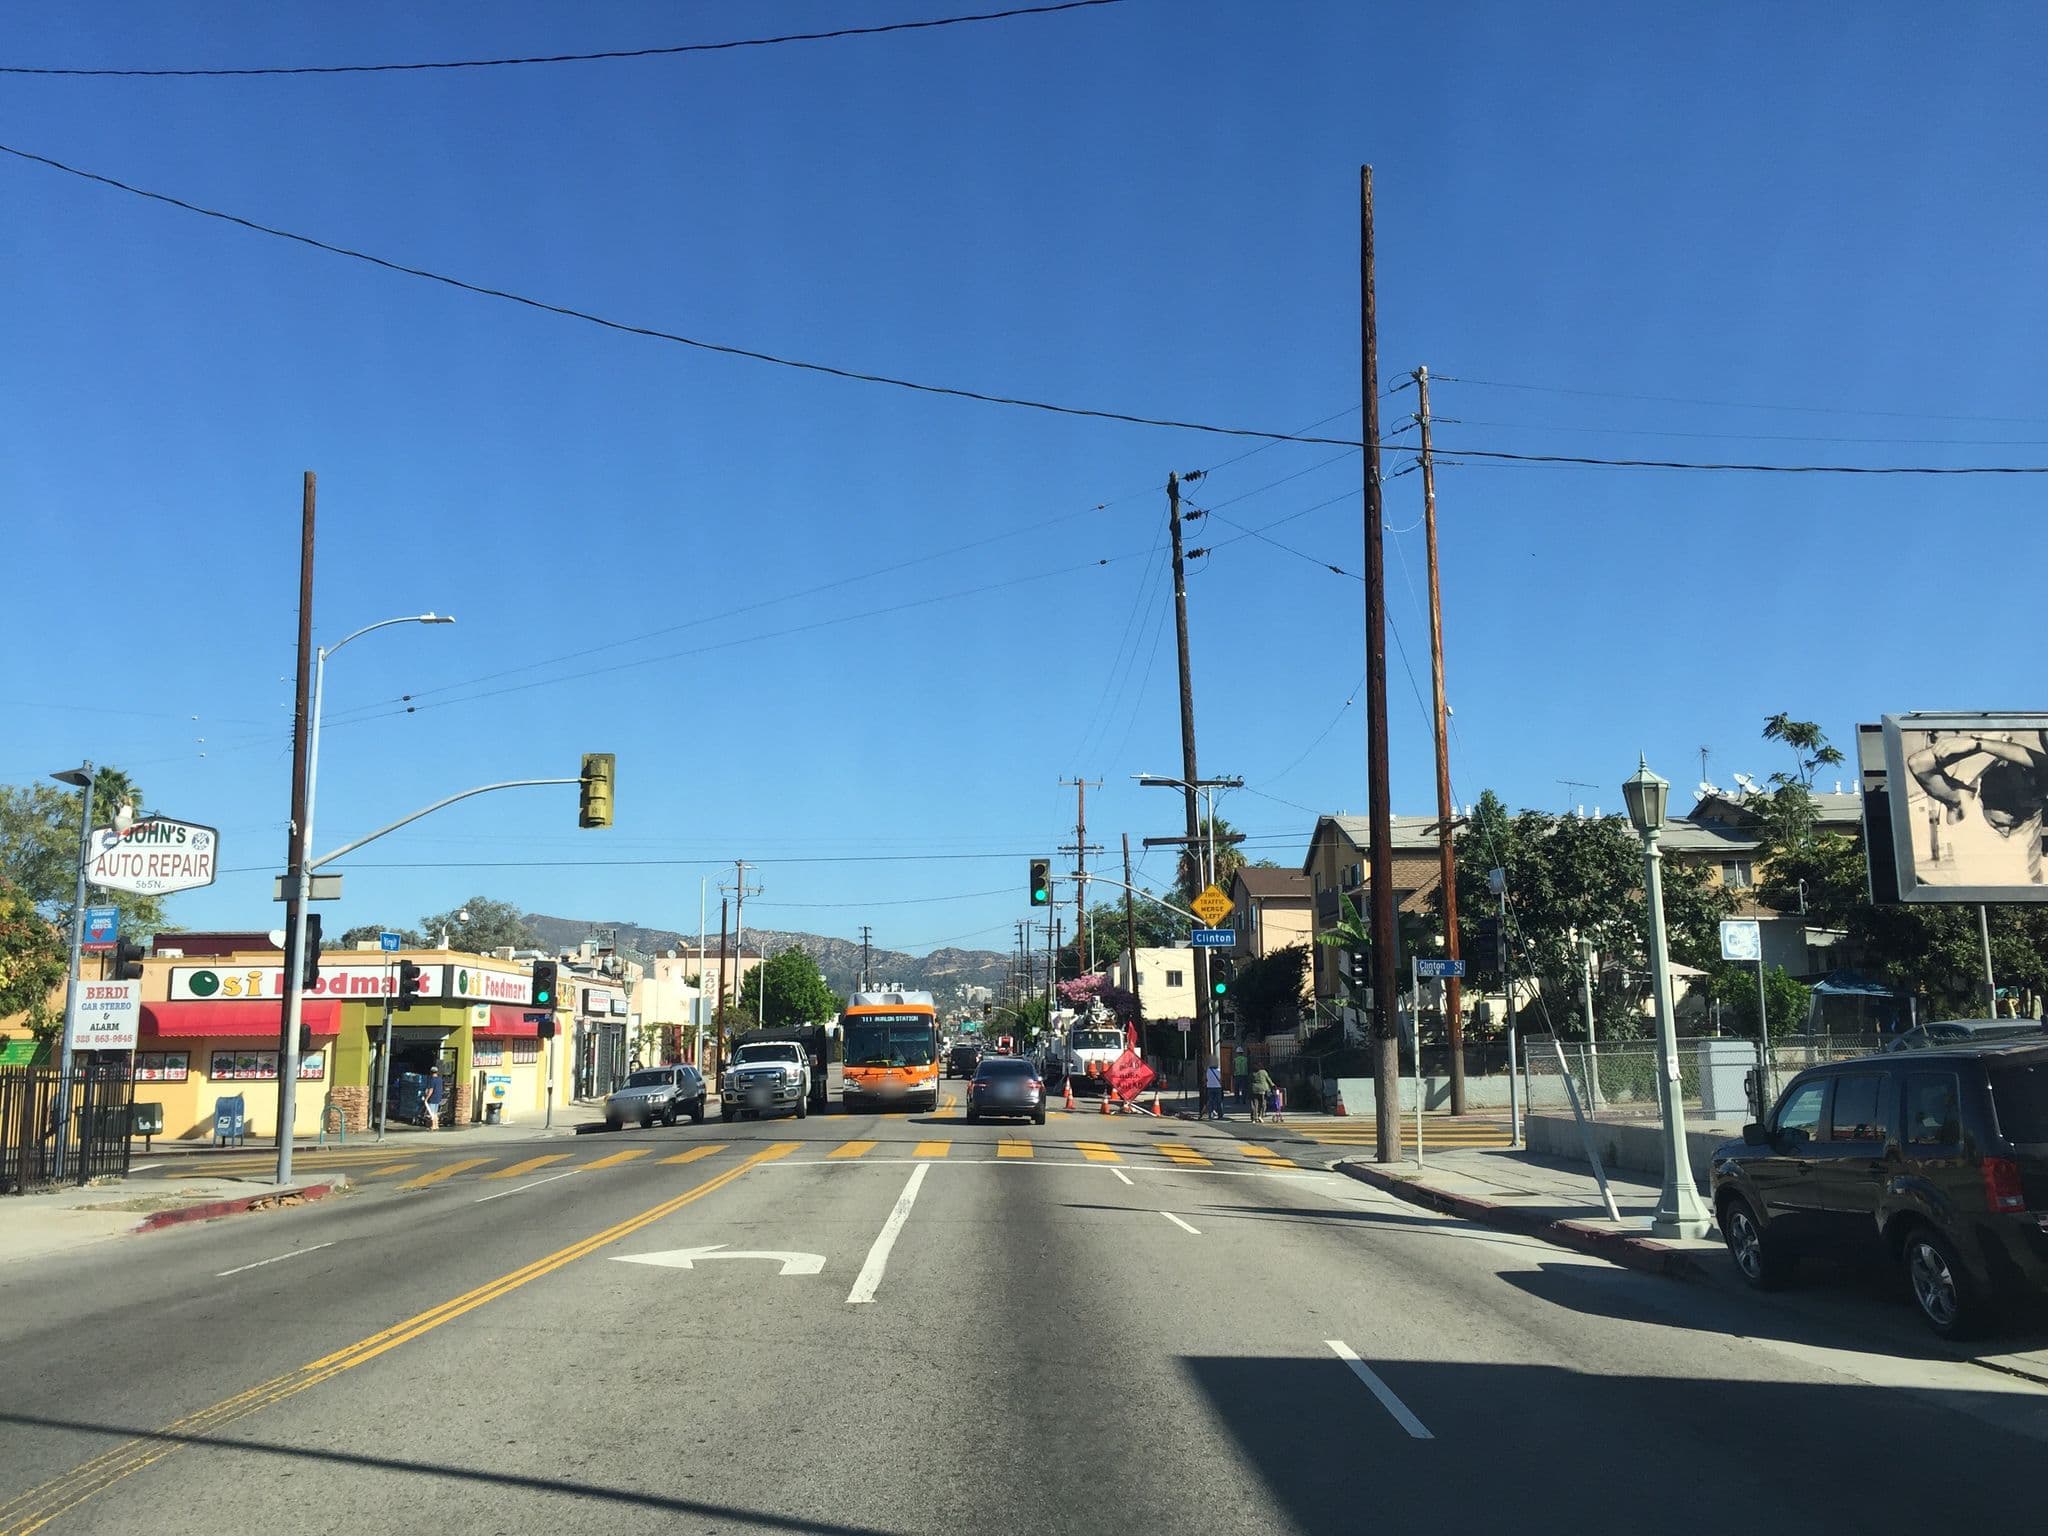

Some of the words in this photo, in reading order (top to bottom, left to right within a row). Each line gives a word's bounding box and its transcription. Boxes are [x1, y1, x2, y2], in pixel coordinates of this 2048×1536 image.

[124, 823, 186, 844] JOHN'S
[95, 853, 143, 877] AUTO
[147, 854, 210, 877] REPAIR
[1196, 933, 1231, 943] Clinton
[1419, 961, 1446, 970] Clinton
[1454, 961, 1463, 971] St
[189, 970, 263, 997] Osi
[485, 975, 527, 1000] Foodmart
[86, 986, 129, 999] BERDI
[81, 1002, 98, 1011] CAR
[99, 1002, 132, 1010] STEREO
[103, 1012, 110, 1020] &
[89, 1022, 119, 1031] ALARM
